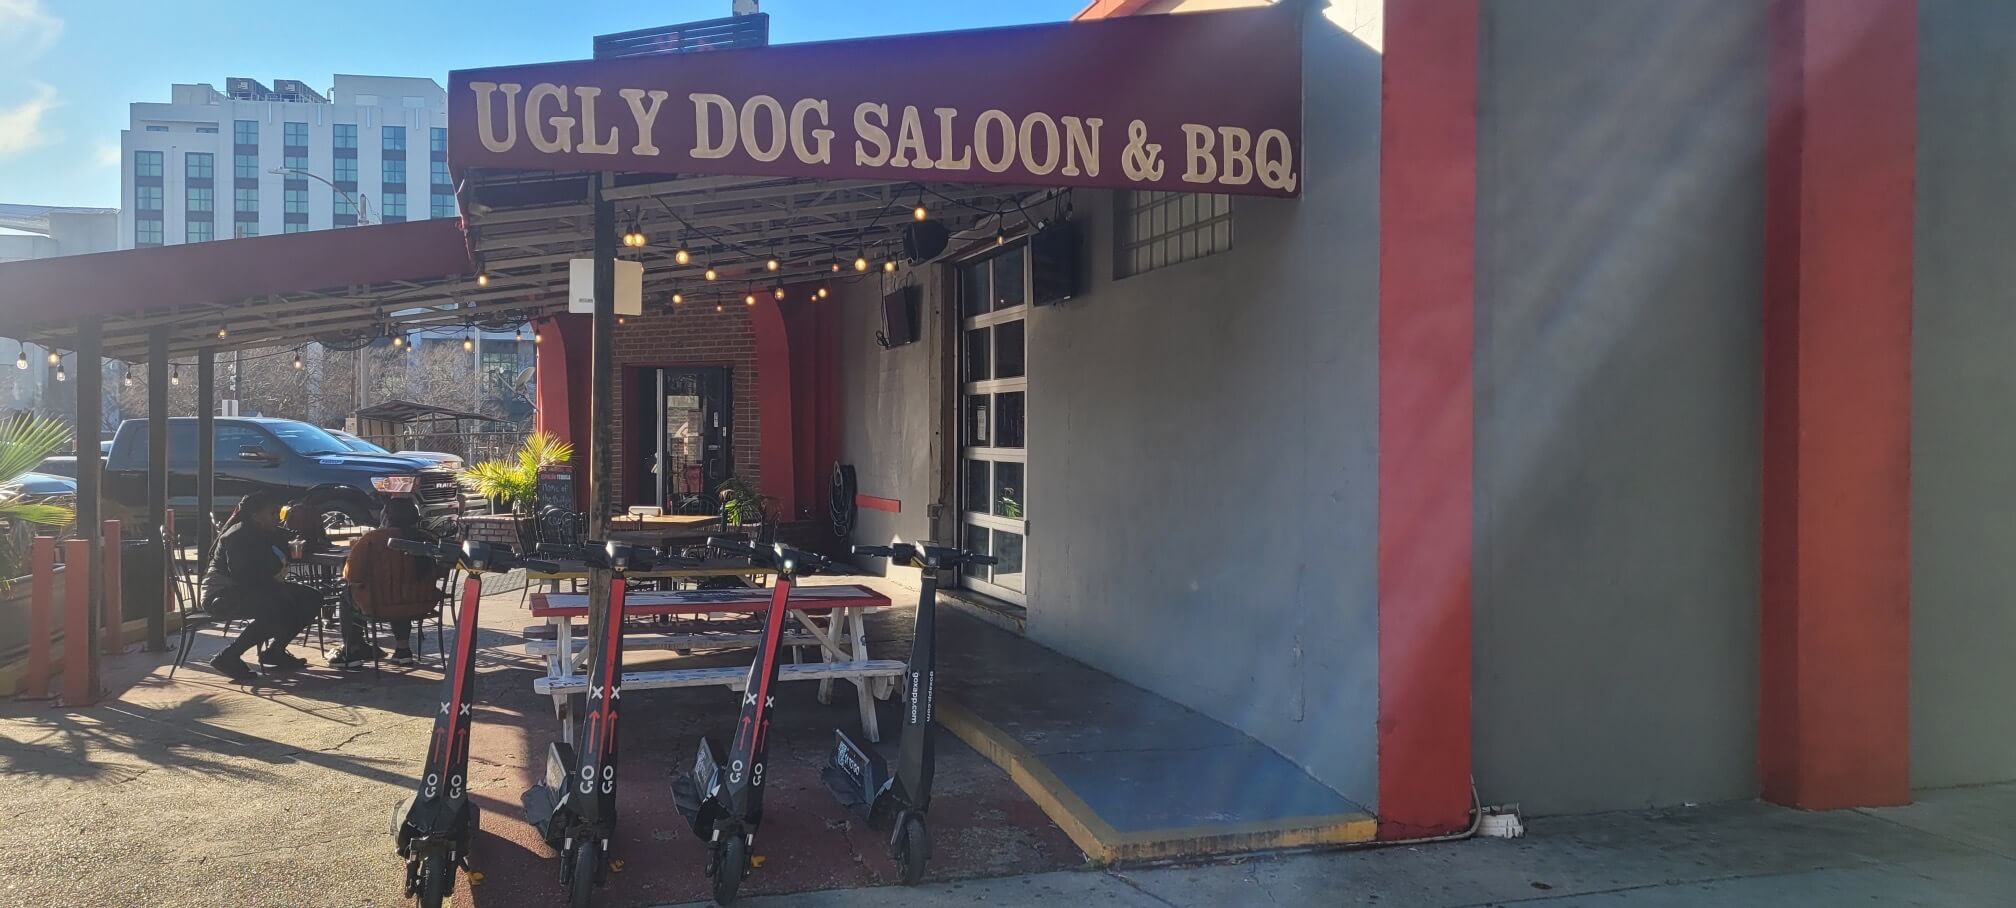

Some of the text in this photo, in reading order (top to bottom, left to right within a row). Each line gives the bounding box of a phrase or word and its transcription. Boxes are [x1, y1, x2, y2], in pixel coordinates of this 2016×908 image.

[470, 81, 1297, 193] UGLY DOG SALOON & BBQ
[910, 672, 921, 724] goxapp.com
[579, 765, 595, 794] GO
[601, 765, 614, 794] GO
[729, 759, 743, 783] GO
[752, 763, 763, 786] GO
[425, 773, 438, 798] GO
[449, 774, 462, 799] GO
